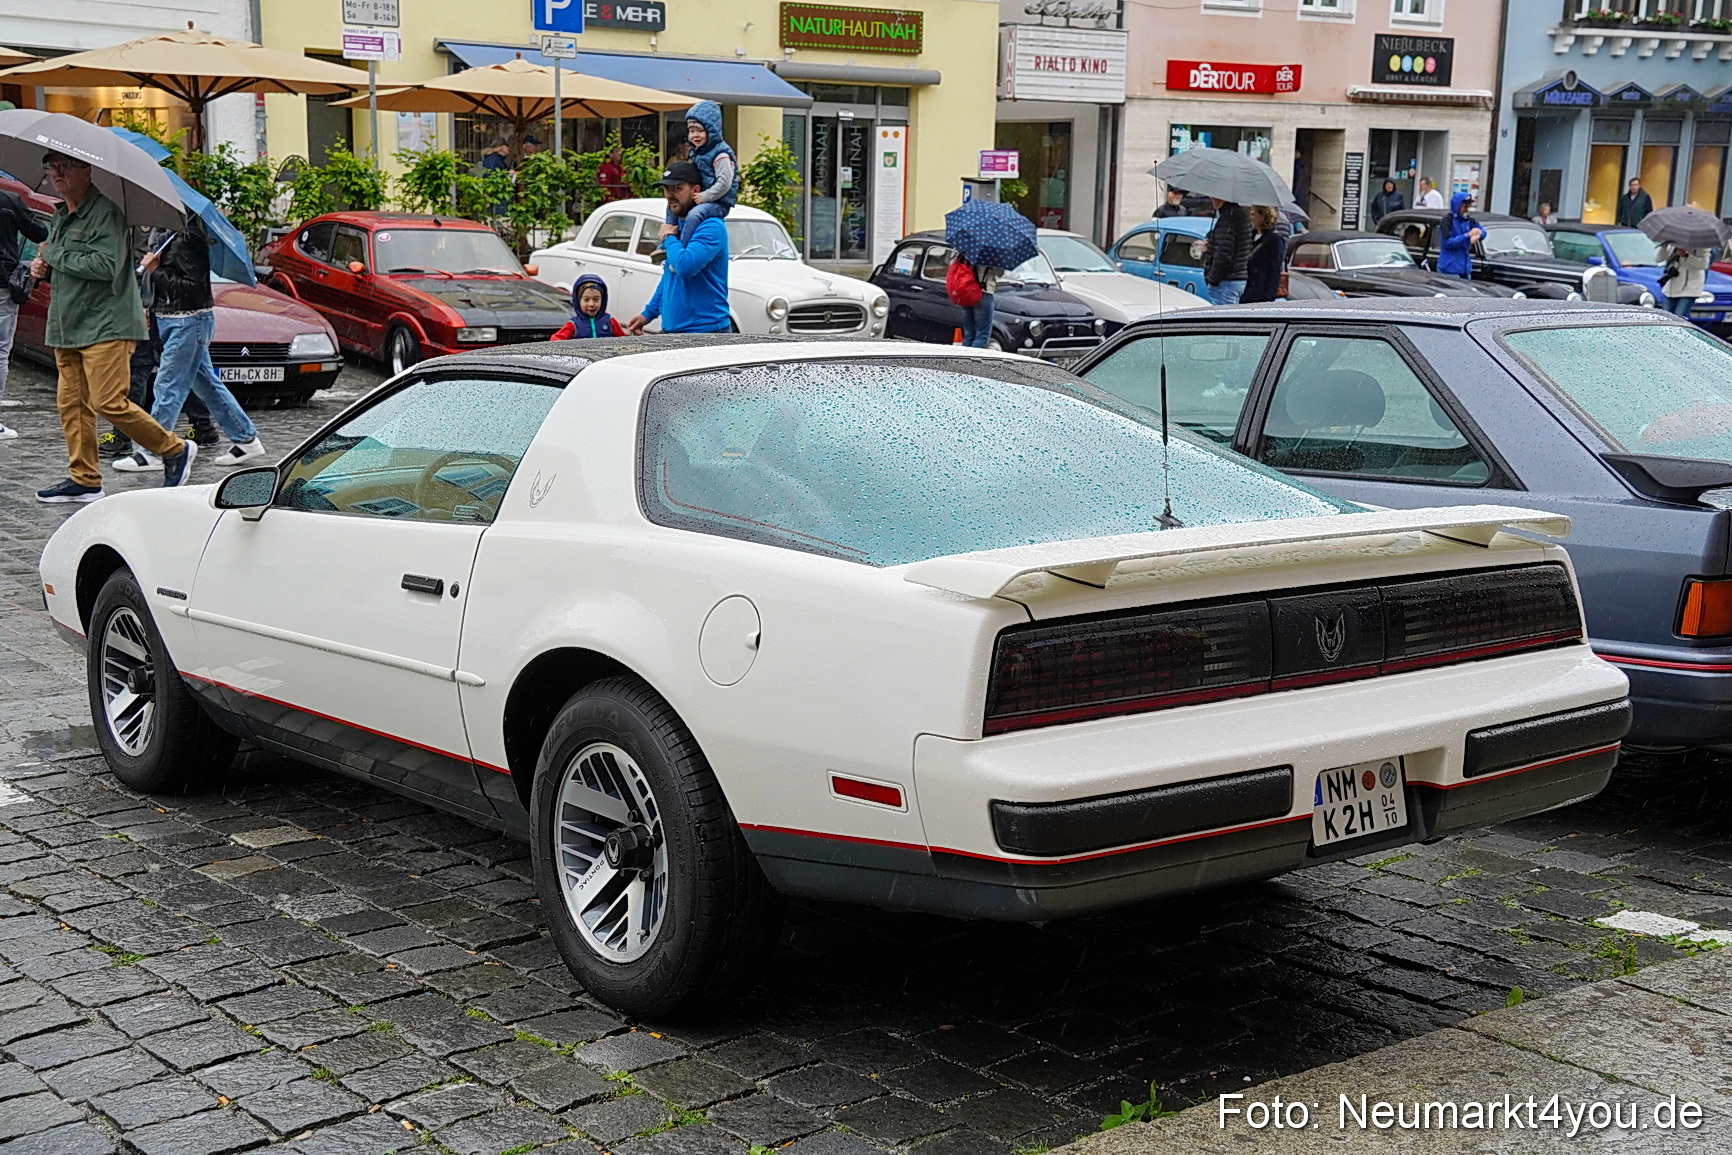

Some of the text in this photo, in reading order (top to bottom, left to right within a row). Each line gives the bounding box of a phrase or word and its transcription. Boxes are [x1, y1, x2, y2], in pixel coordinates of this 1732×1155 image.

[545, 0, 571, 24] P
[601, 5, 613, 19] &
[616, 6, 661, 23] MEHR
[790, 15, 917, 41] NATURHAUTNAH
[1005, 27, 1015, 95] KINO
[1034, 55, 1108, 74] RIALTO KINO
[1275, 82, 1294, 91] TOUR
[847, 124, 863, 253] NATURHAUTNAH
[964, 187, 971, 202] P
[220, 368, 241, 380] KEH
[247, 368, 261, 380] CX
[263, 368, 278, 380] 8H
[1326, 768, 1358, 804] NM
[1381, 792, 1396, 807] 04
[1384, 811, 1398, 827] 10
[579, 859, 605, 890] PONTIAC
